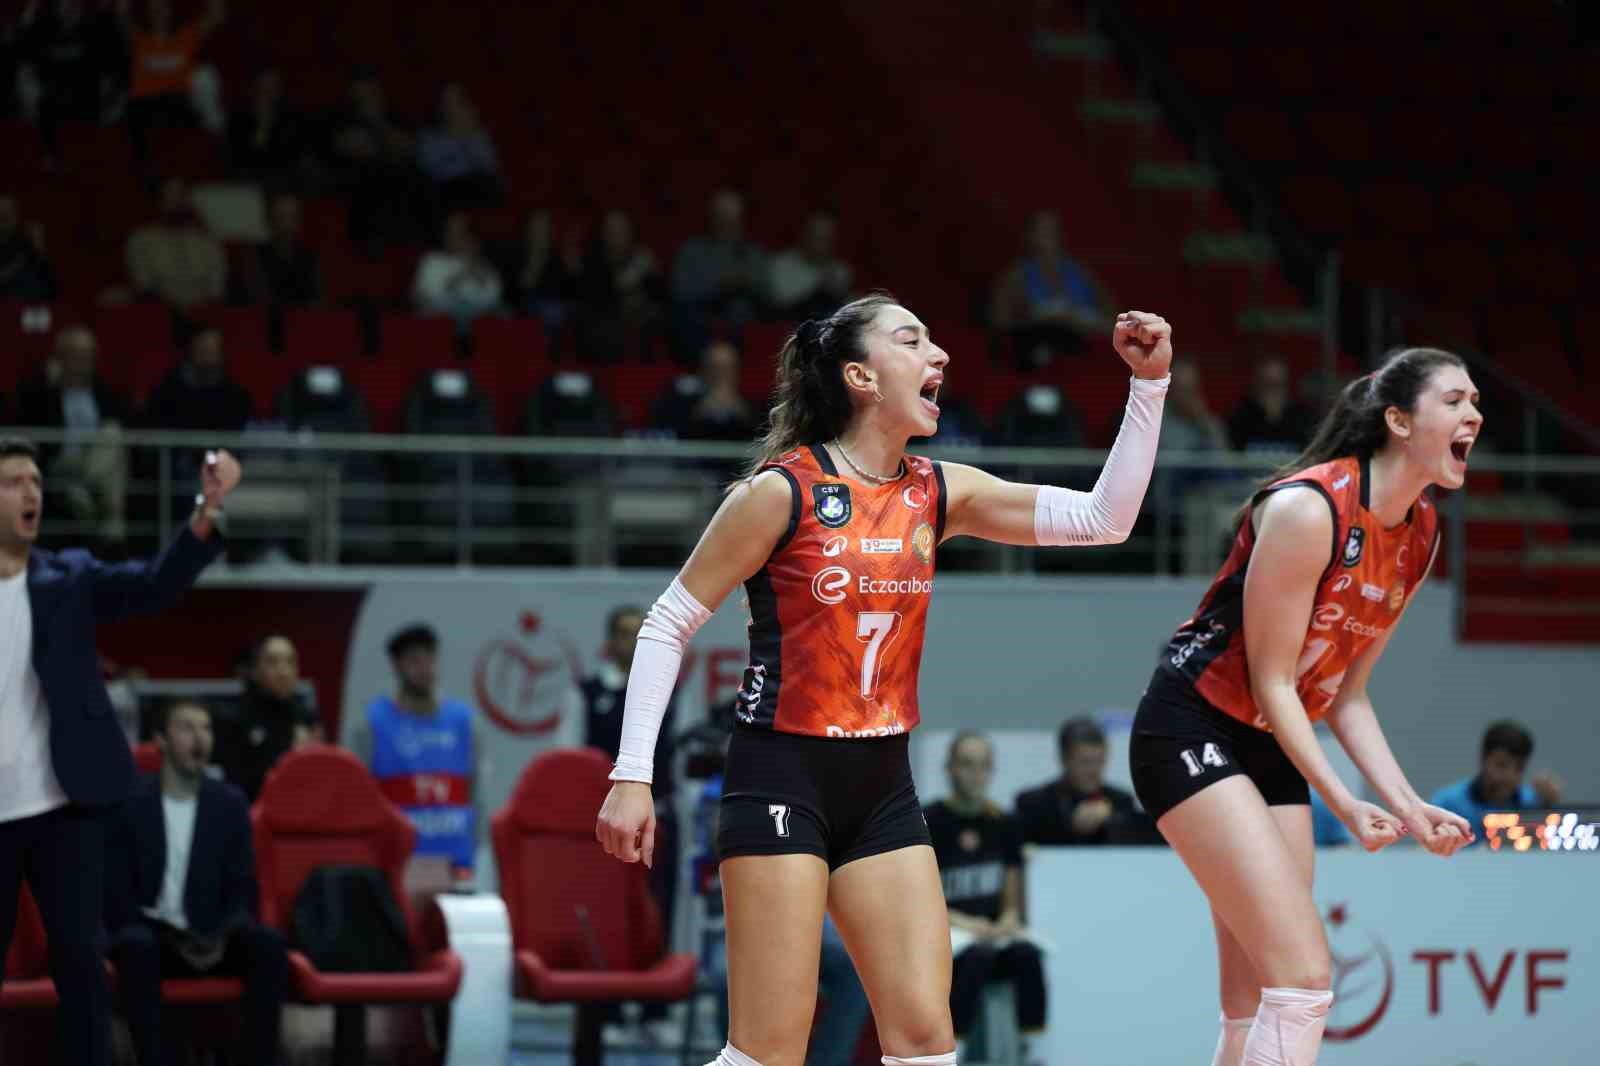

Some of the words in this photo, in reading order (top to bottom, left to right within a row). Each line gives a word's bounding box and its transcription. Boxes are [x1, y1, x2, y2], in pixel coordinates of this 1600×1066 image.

[856, 611, 902, 701] 7
[1180, 741, 1228, 777] 14
[768, 803, 790, 838] 7
[1411, 949, 1570, 1017] TVF
